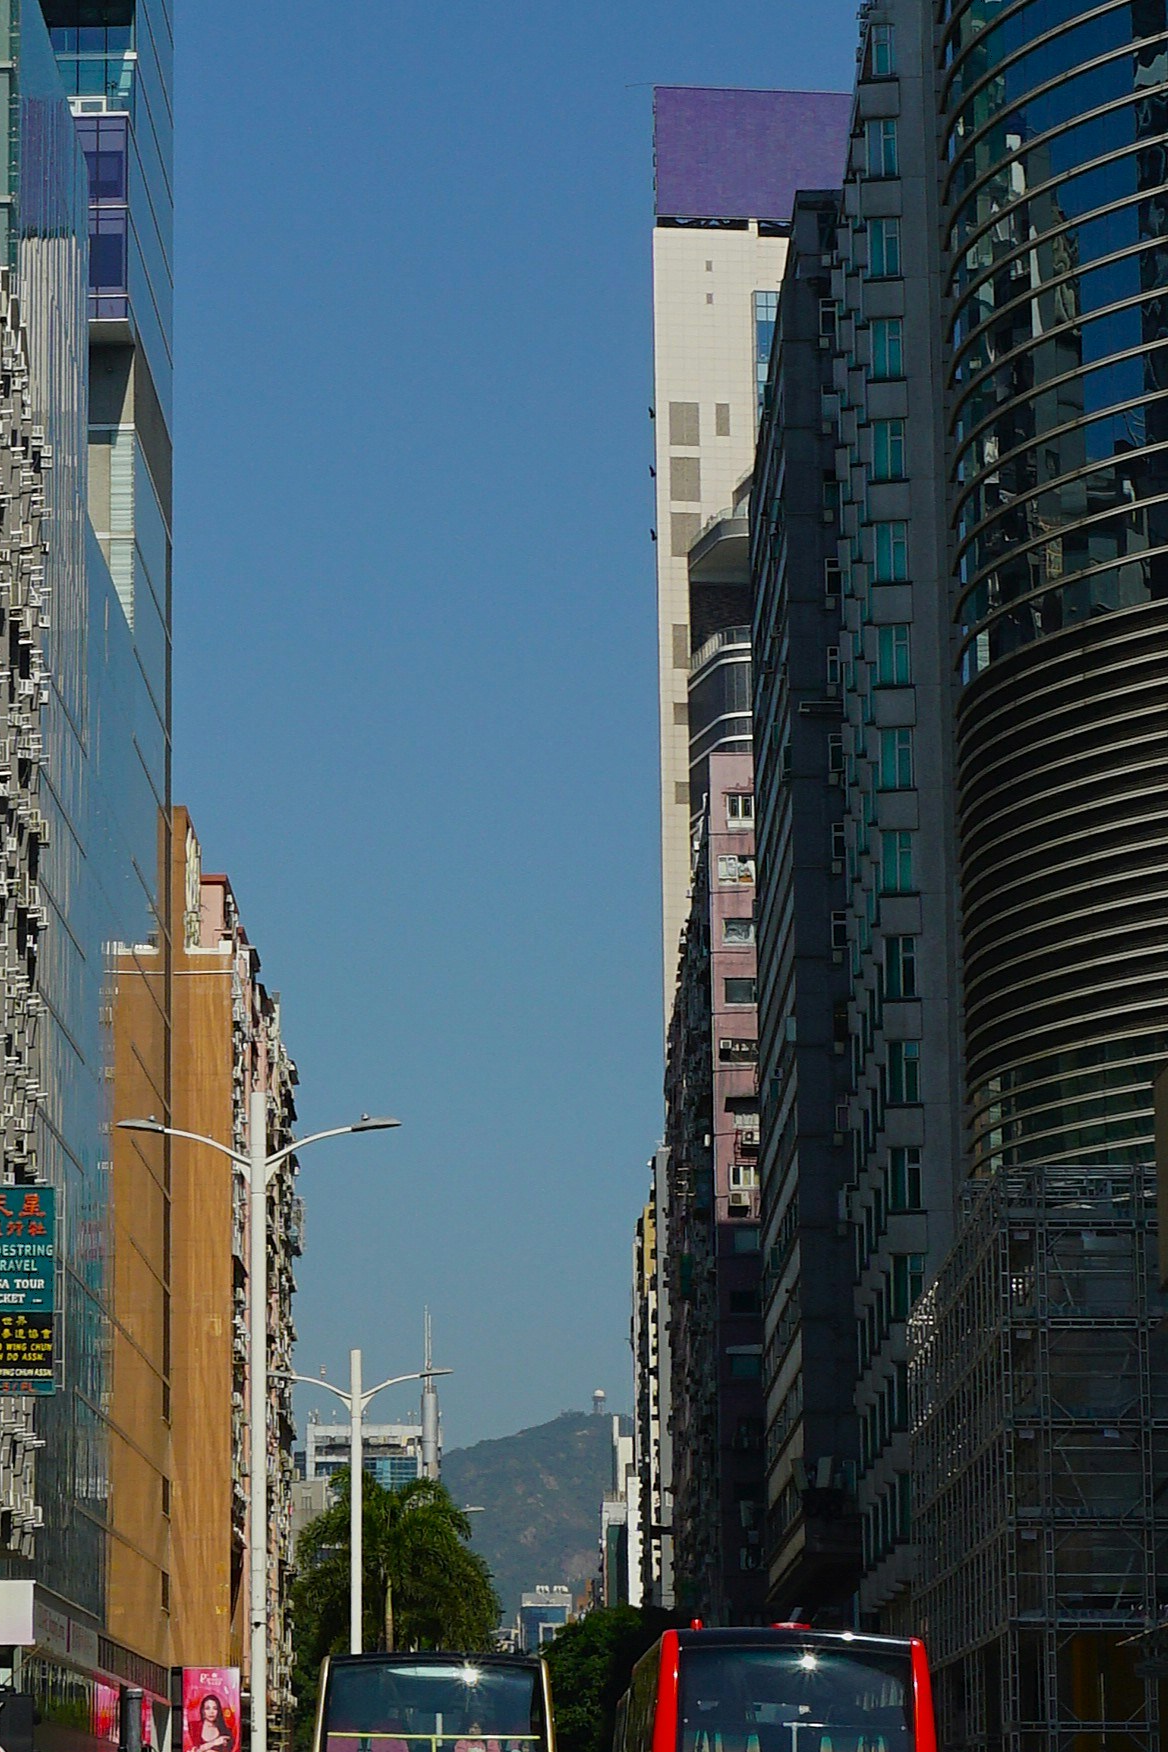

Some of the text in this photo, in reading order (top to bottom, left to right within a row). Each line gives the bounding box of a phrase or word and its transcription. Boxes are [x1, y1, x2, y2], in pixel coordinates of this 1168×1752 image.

[13, 1279, 45, 1289] TOUR
[6, 1342, 27, 1351] WING
[30, 1342, 53, 1351] CHUN
[6, 1352, 19, 1361] DO
